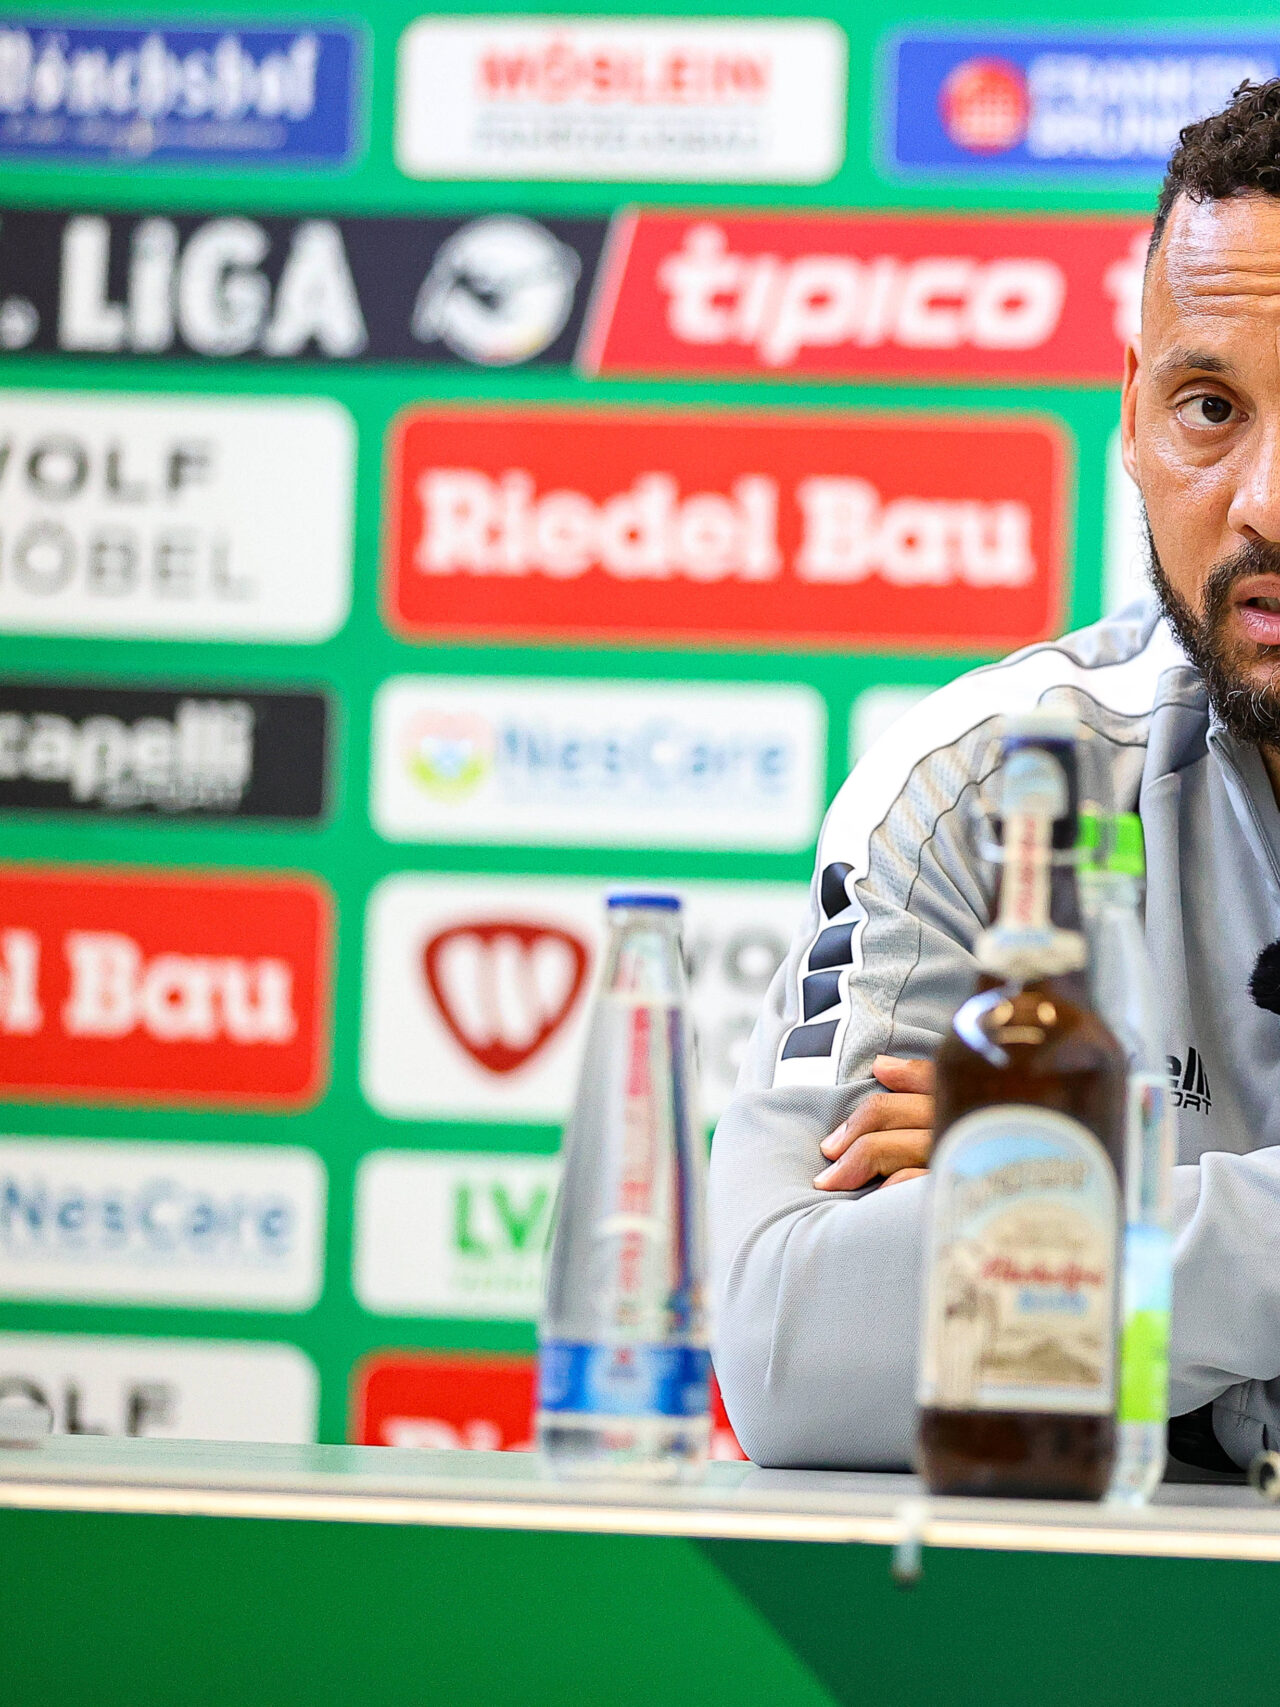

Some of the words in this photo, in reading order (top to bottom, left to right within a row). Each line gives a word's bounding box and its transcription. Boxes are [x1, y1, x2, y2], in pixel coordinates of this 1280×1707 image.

[478, 32, 772, 104] MÖSLEIN
[657, 222, 1068, 367] tipico
[0, 516, 262, 600] ÖBEL
[415, 465, 783, 582] Riedel
[795, 475, 1036, 587] Bau
[63, 928, 299, 1047] Bau
[448, 1176, 552, 1260] LV
